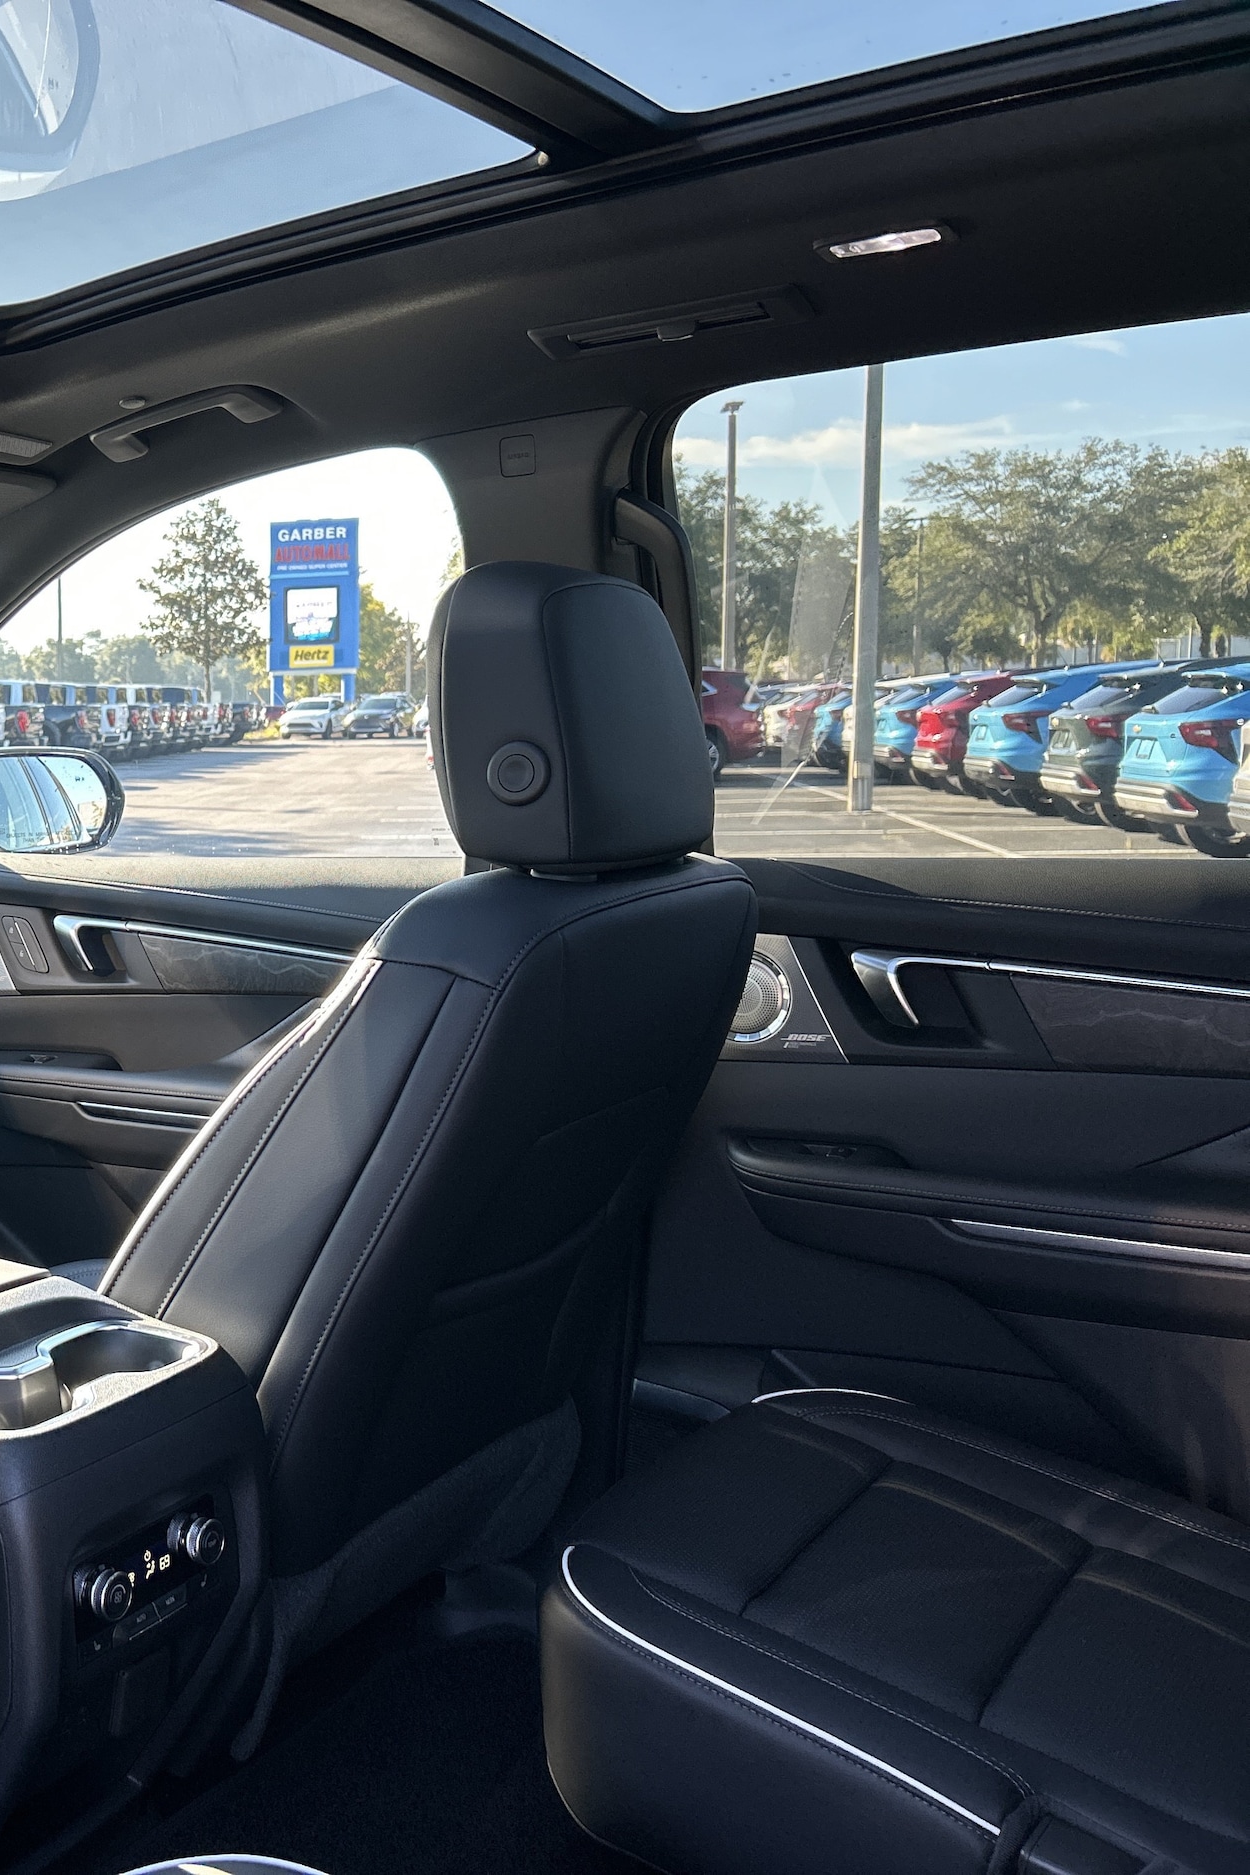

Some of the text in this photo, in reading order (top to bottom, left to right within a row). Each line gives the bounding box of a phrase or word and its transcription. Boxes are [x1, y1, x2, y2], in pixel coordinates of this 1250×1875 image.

[278, 527, 347, 542] GARBER
[275, 543, 350, 563] AUTOMALL
[294, 649, 330, 661] Hertz
[781, 1033, 831, 1042] BOSE
[159, 1554, 170, 1571] 69
